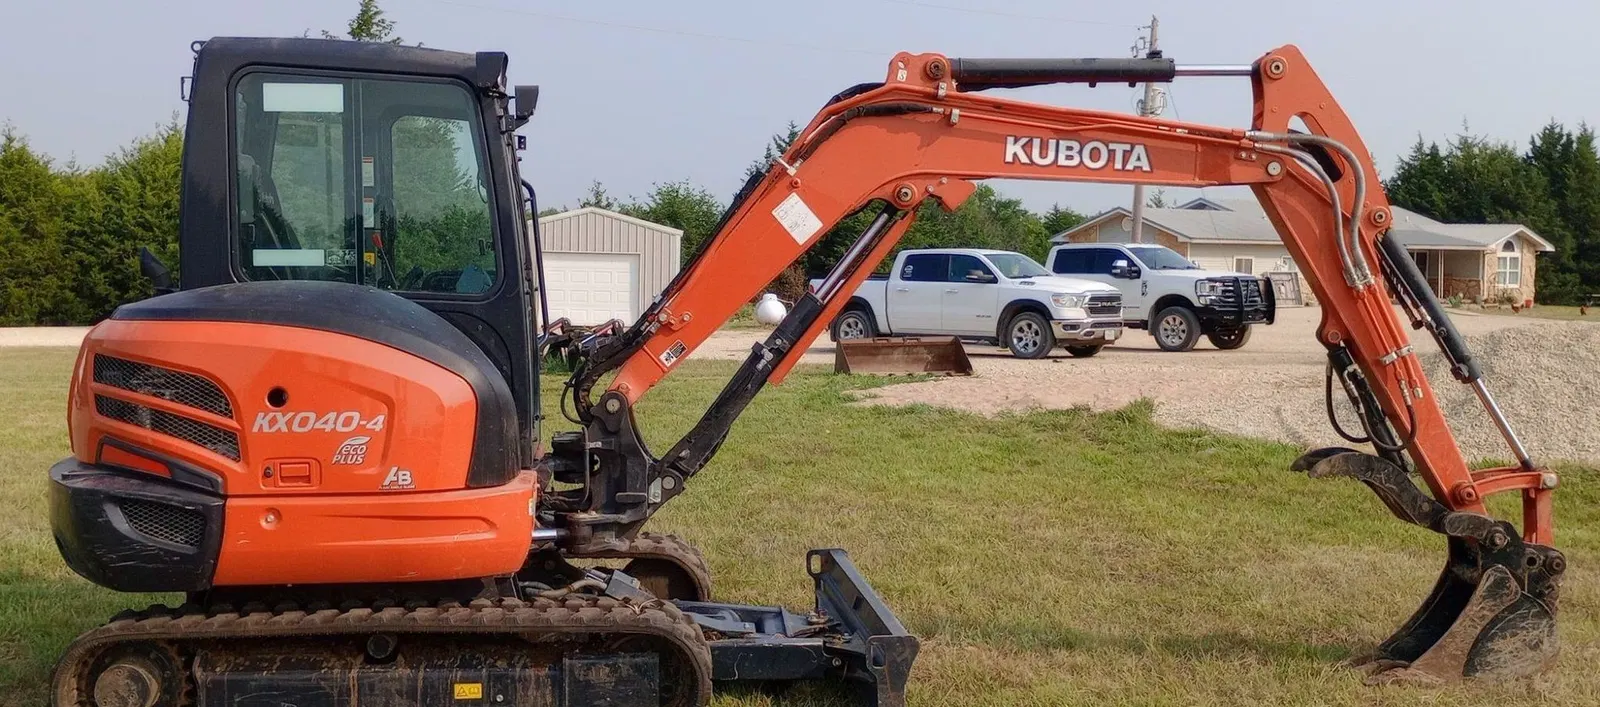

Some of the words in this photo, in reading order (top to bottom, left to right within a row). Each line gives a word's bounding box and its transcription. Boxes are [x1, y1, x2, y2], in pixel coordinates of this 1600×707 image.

[1004, 135, 1153, 172] KUBOTA
[252, 411, 386, 433] KX040-4
[341, 445, 367, 455] eco
[331, 454, 365, 465] PLUS
